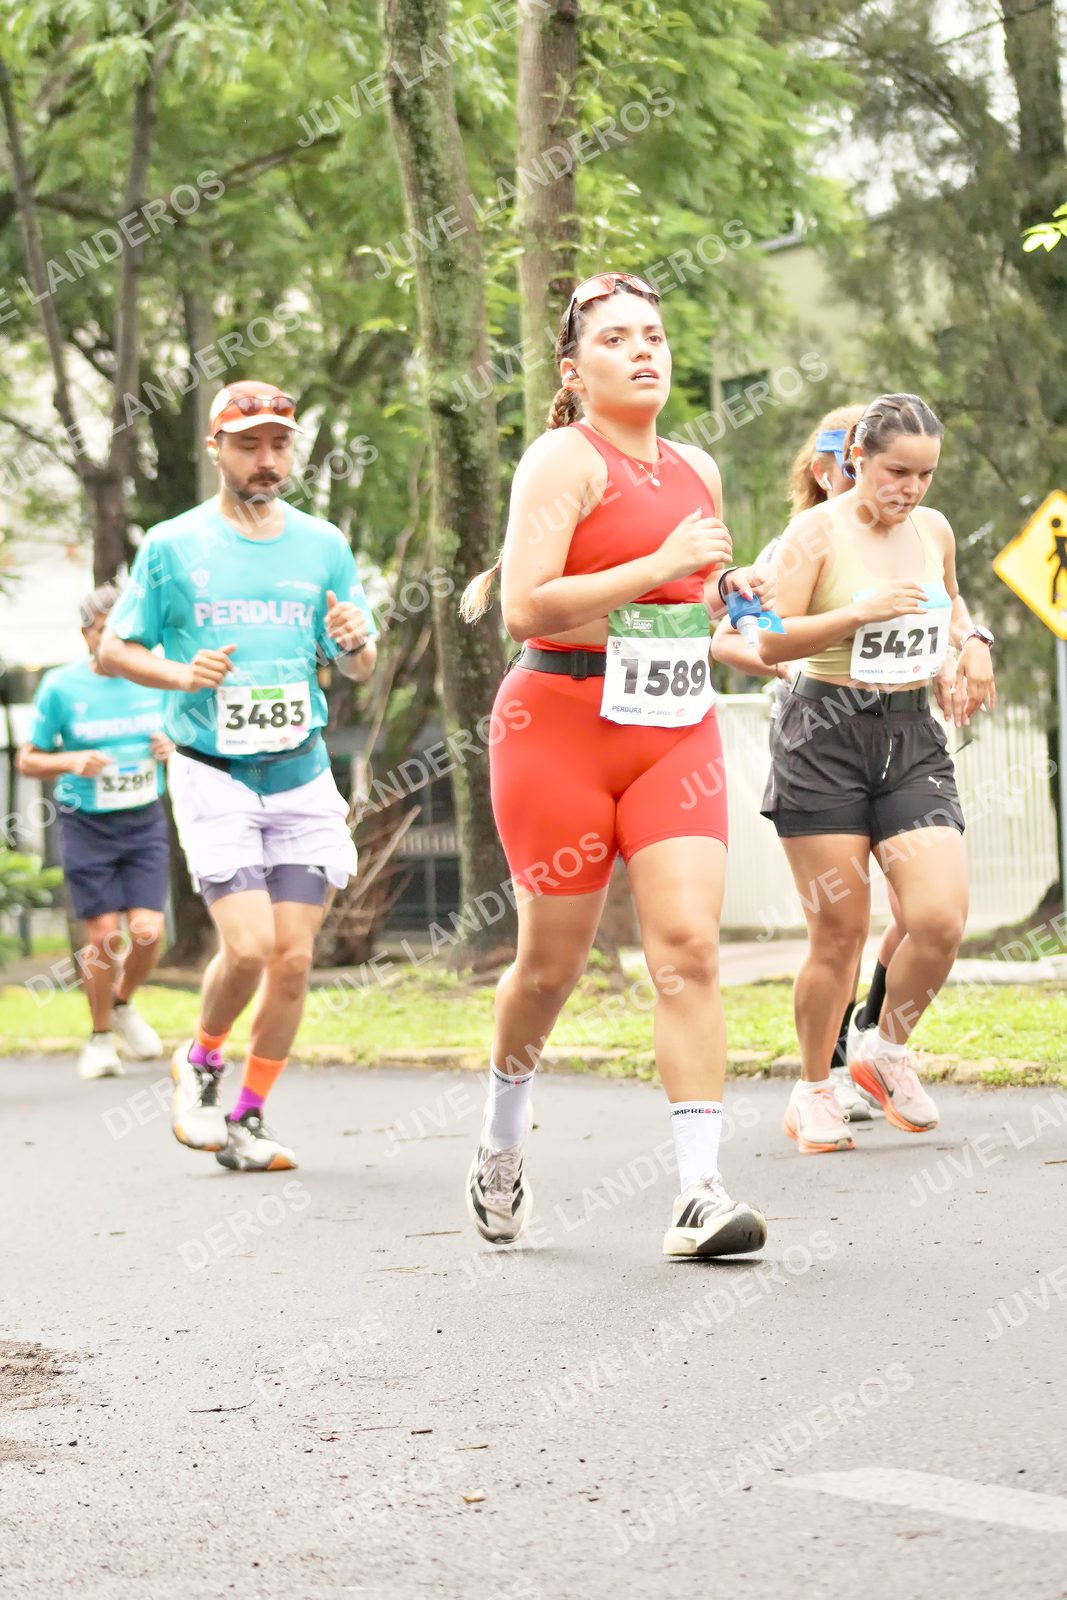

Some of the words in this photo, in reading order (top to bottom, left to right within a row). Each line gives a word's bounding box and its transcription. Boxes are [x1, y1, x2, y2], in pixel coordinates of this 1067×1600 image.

[859, 626, 939, 660] 5421
[620, 658, 707, 697] 1589
[226, 700, 305, 730] 3483
[612, 705, 642, 714] PERDURA
